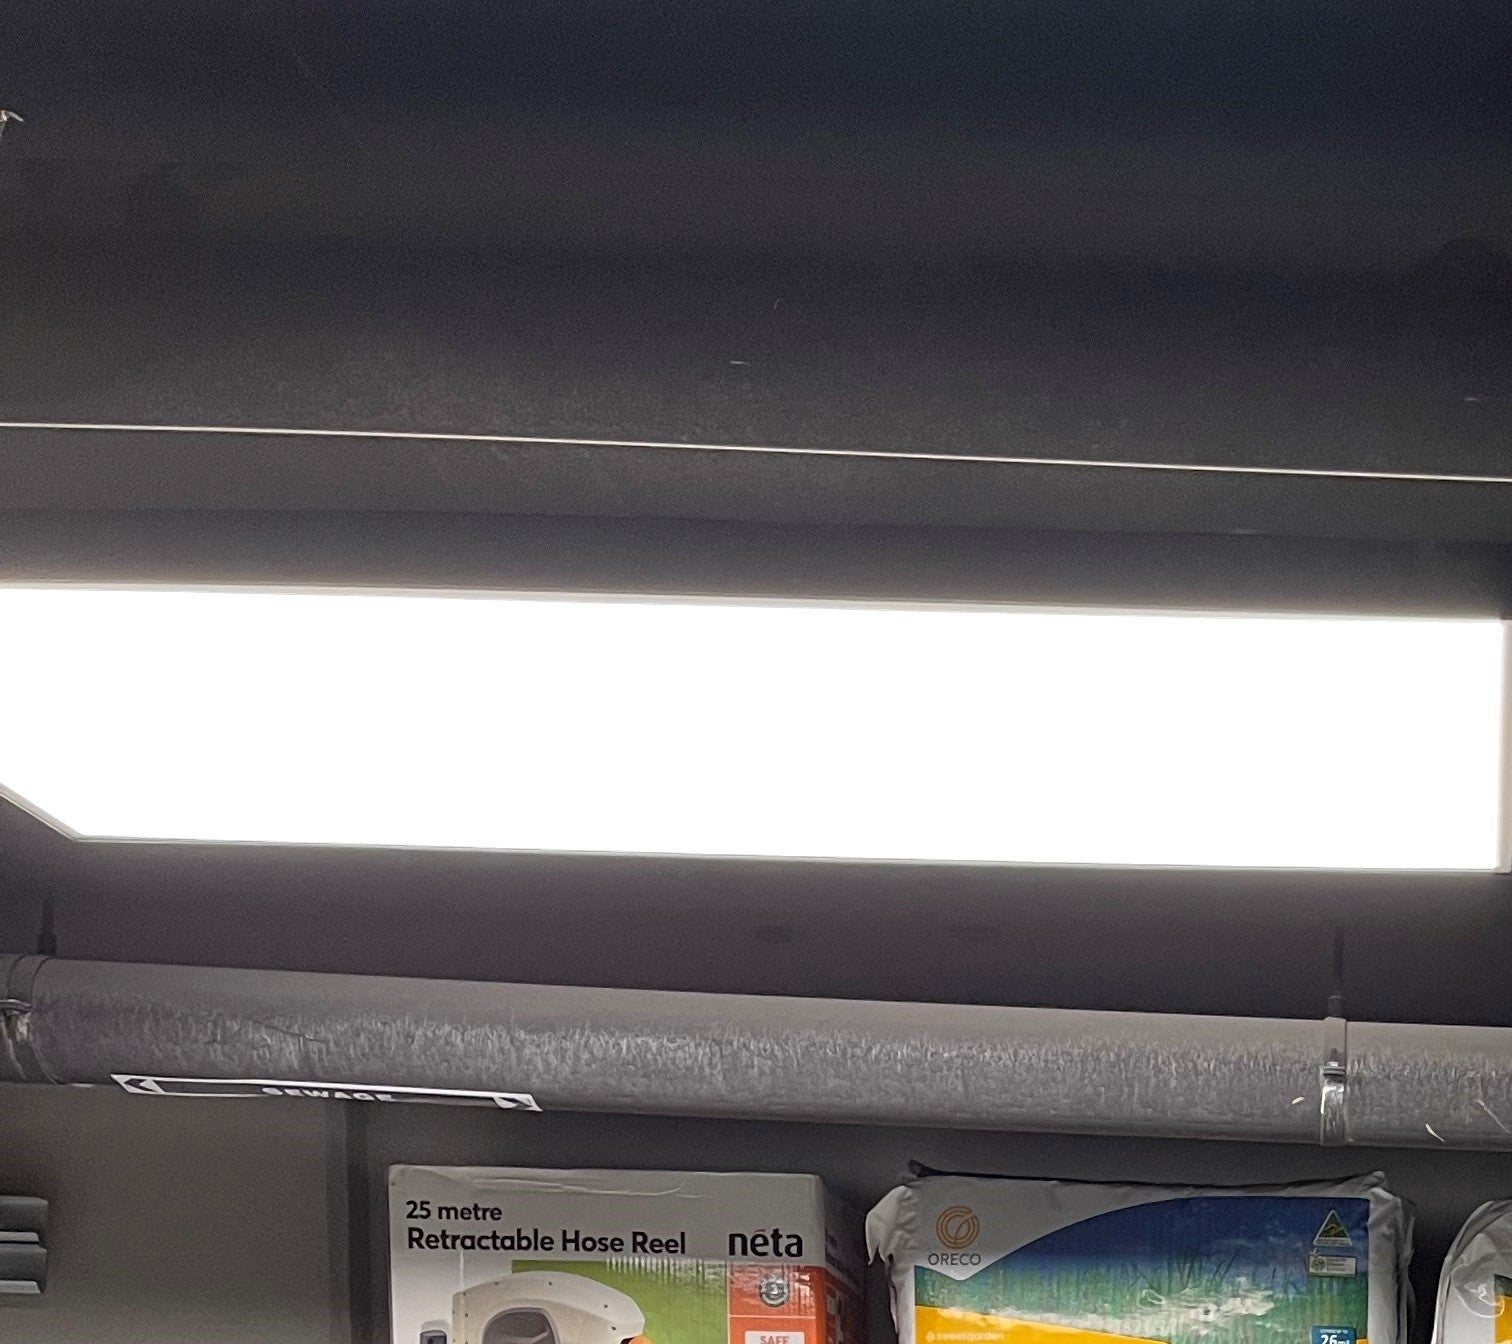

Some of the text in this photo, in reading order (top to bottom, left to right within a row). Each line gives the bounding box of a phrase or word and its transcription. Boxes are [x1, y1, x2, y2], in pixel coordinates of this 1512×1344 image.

[406, 1200, 503, 1221] 25 metre
[408, 1226, 687, 1255] Retractable Hose Reel
[928, 1252, 981, 1266] ORECO
